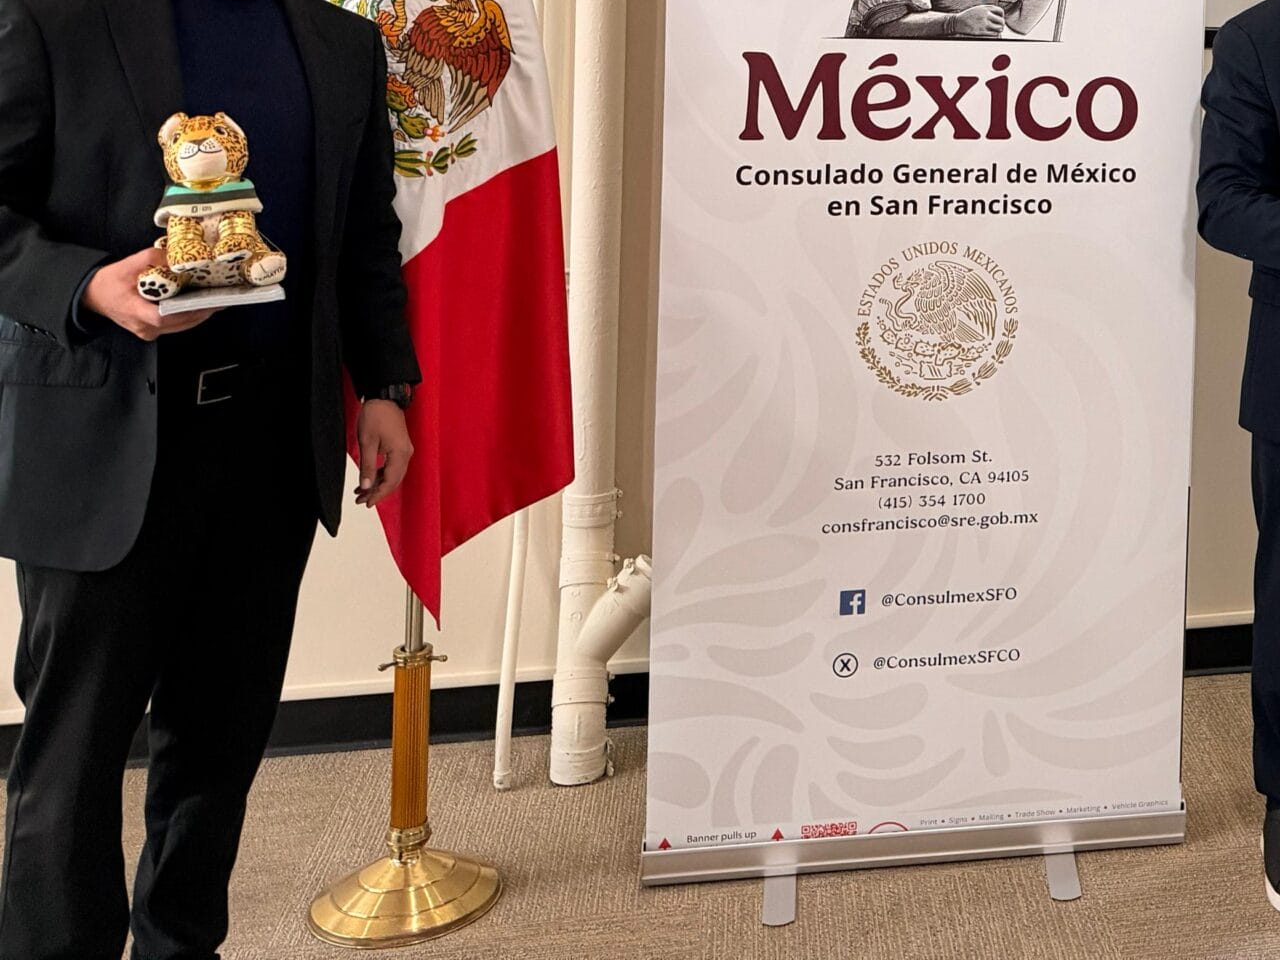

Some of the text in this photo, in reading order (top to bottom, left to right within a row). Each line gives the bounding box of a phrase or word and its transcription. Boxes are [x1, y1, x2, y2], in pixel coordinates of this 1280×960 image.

[738, 52, 1139, 142] México
[735, 162, 1137, 186] Consulado General de México
[827, 194, 1053, 216] en San Francisco
[857, 240, 1019, 317] ESTADOS UNIDOS MEXICANOS
[874, 450, 993, 467] 532 Folsom St.
[833, 470, 1030, 491] San Francisco, CA 94105
[878, 493, 986, 510] (415) 354 1700
[821, 511, 1039, 534] consfrancisco@sre.gob.mx
[881, 587, 1018, 607] @ConsulmexSFO
[873, 648, 1021, 670] @ConsulmexSFCO
[1036, 808, 1056, 817] Show
[686, 830, 757, 843] Banner pulls up
